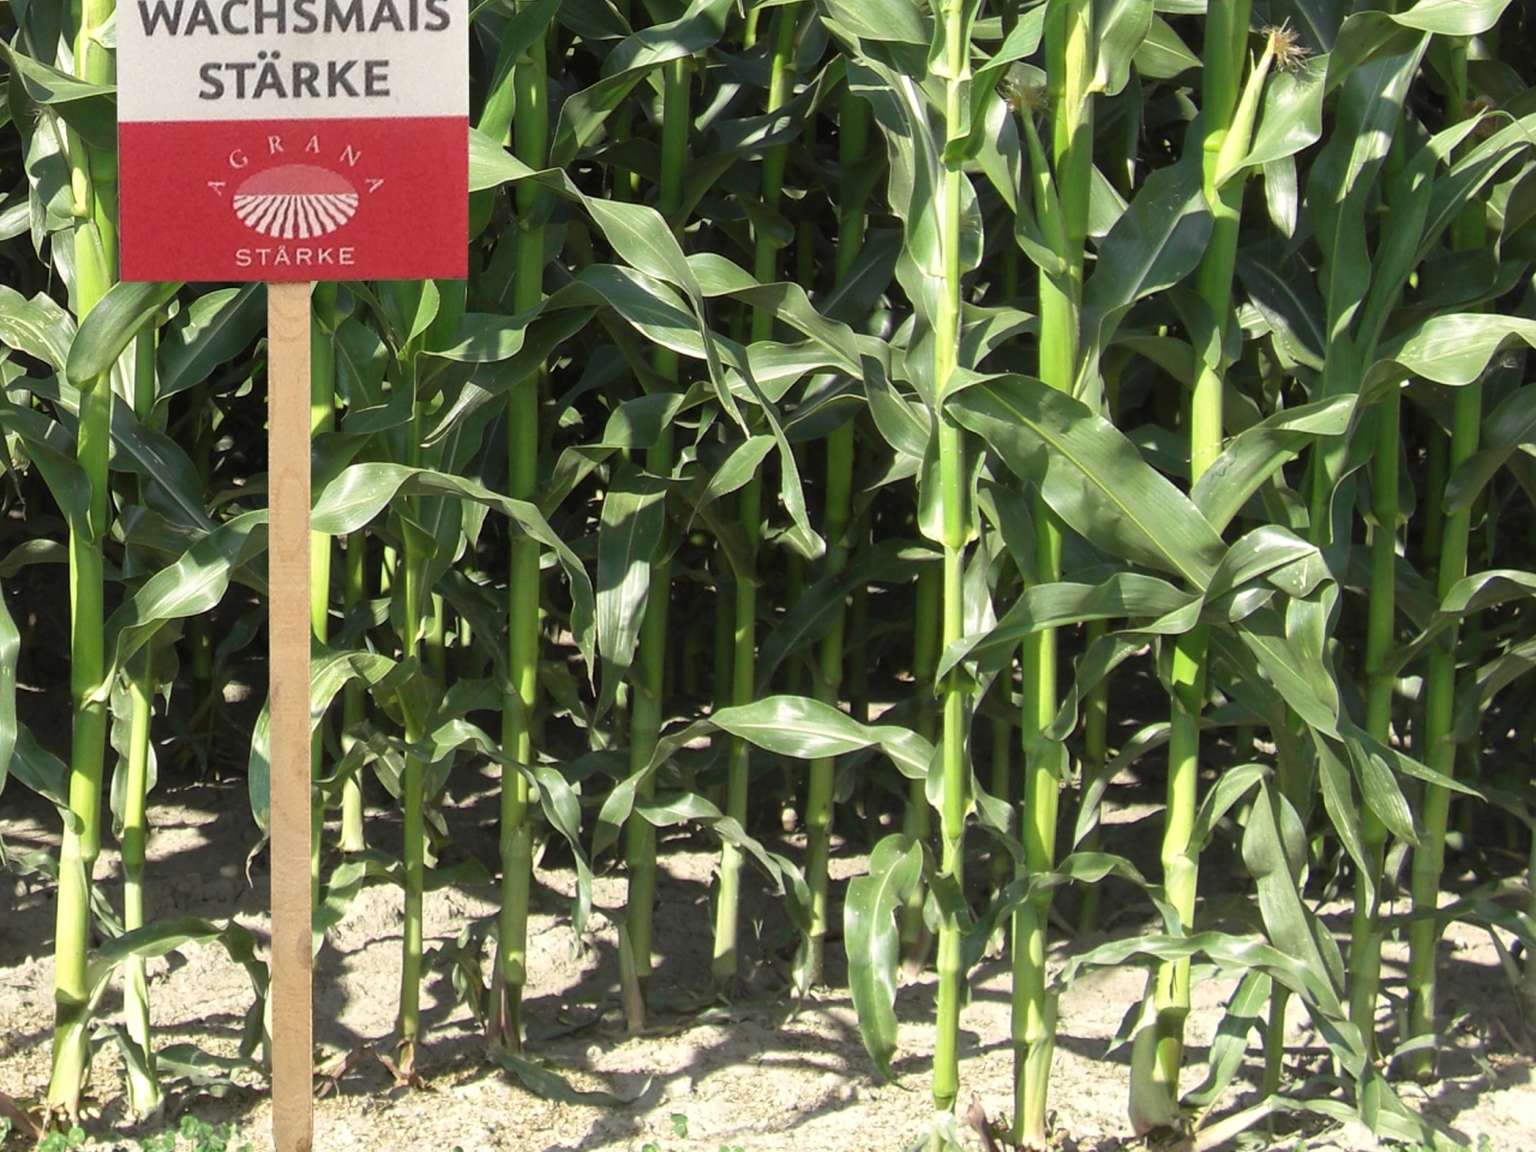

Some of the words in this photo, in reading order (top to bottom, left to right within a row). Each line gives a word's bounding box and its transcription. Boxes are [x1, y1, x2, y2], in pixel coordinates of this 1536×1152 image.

[198, 50, 390, 100] STÄRKE
[207, 134, 385, 195] AGRANA
[234, 242, 356, 267] STÄRKE
